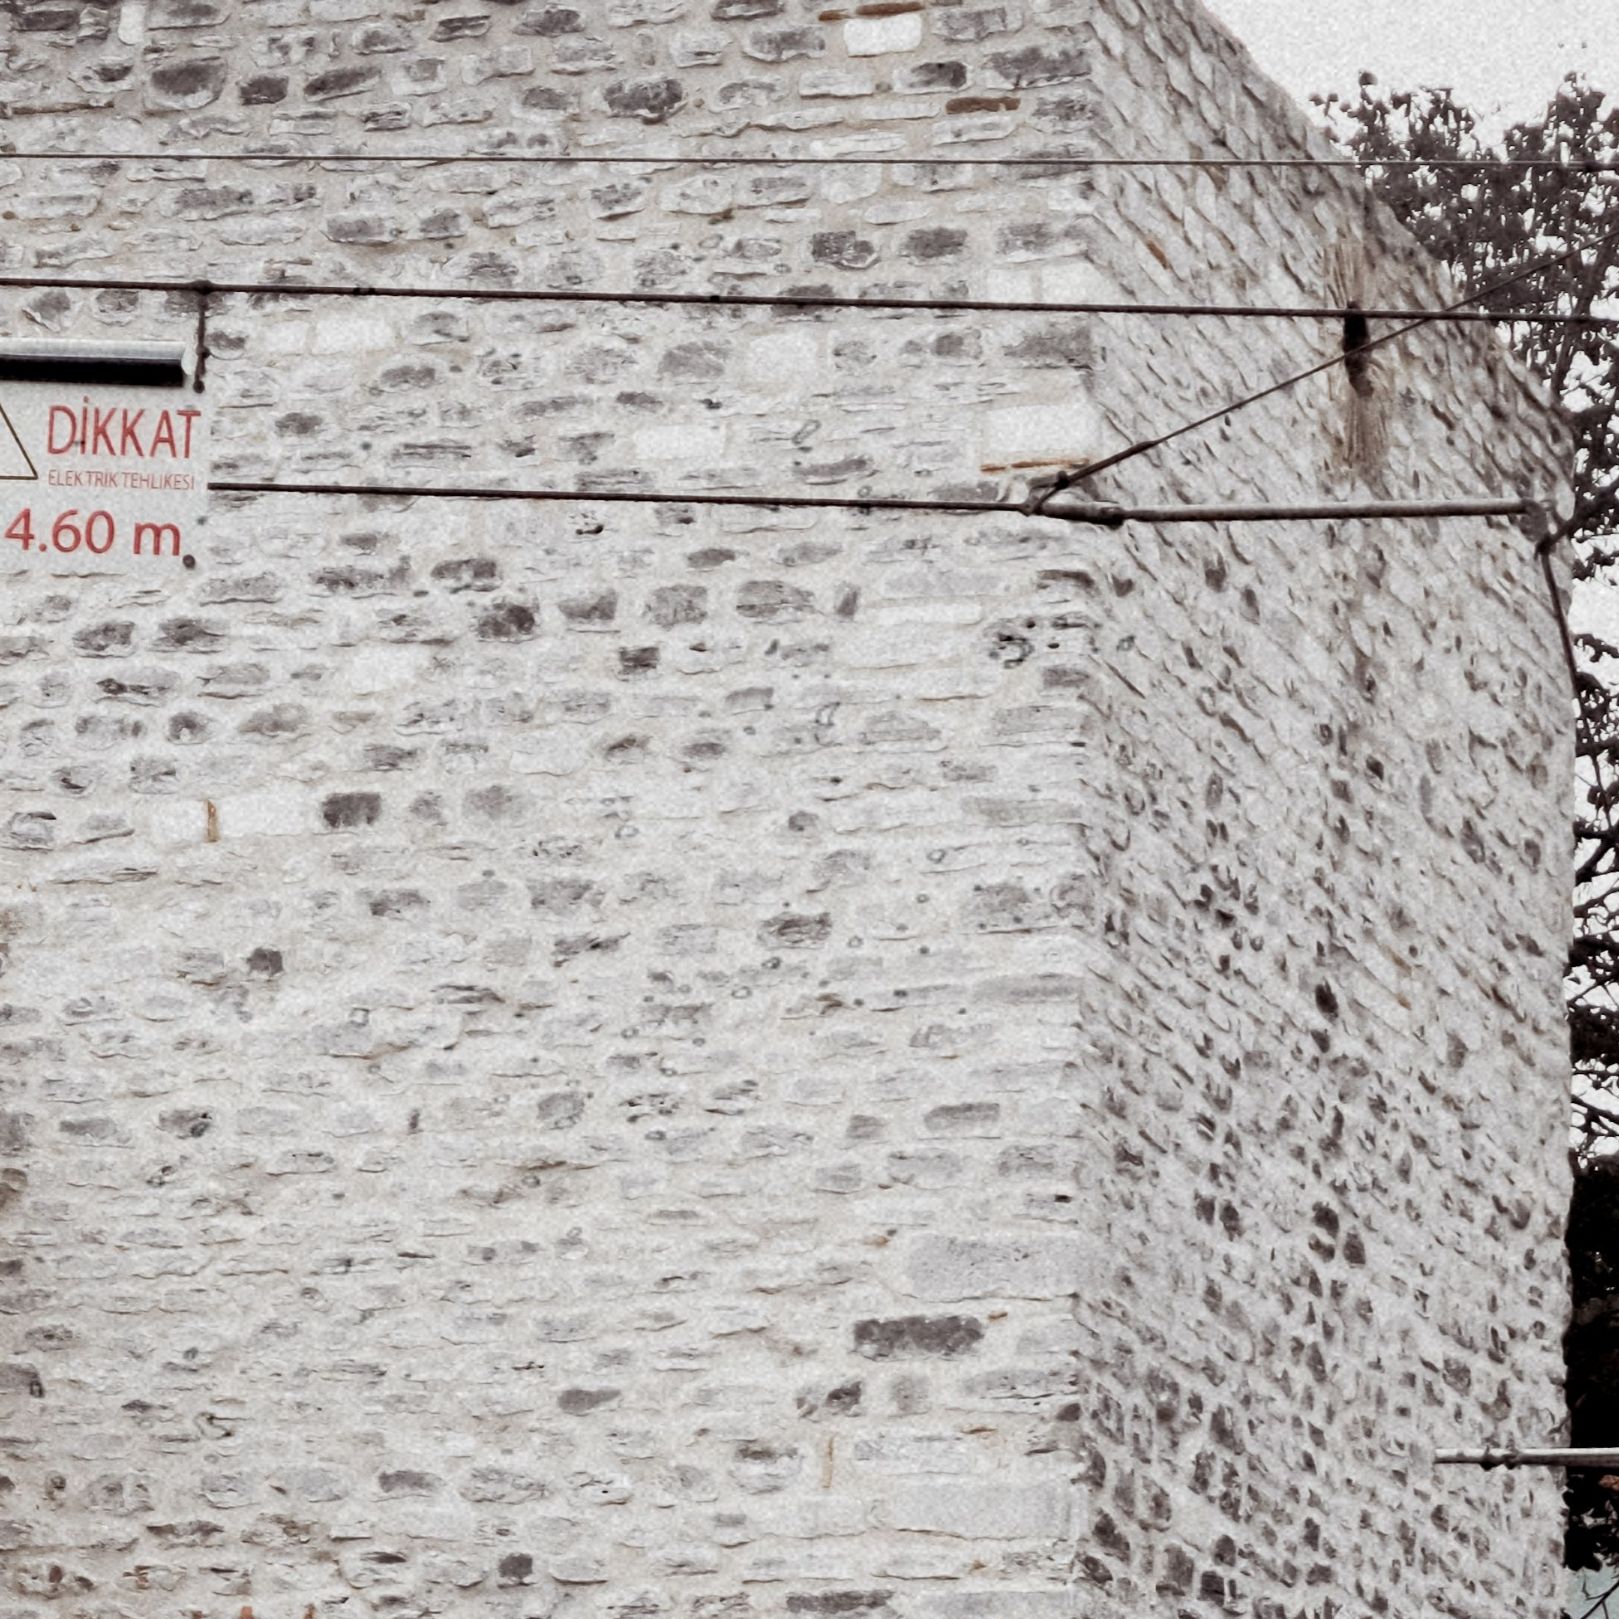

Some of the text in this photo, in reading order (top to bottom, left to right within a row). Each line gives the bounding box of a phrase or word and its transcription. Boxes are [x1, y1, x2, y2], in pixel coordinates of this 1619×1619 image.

[47, 396, 202, 458] DİKKAT
[4, 508, 182, 556] 4.60 m
